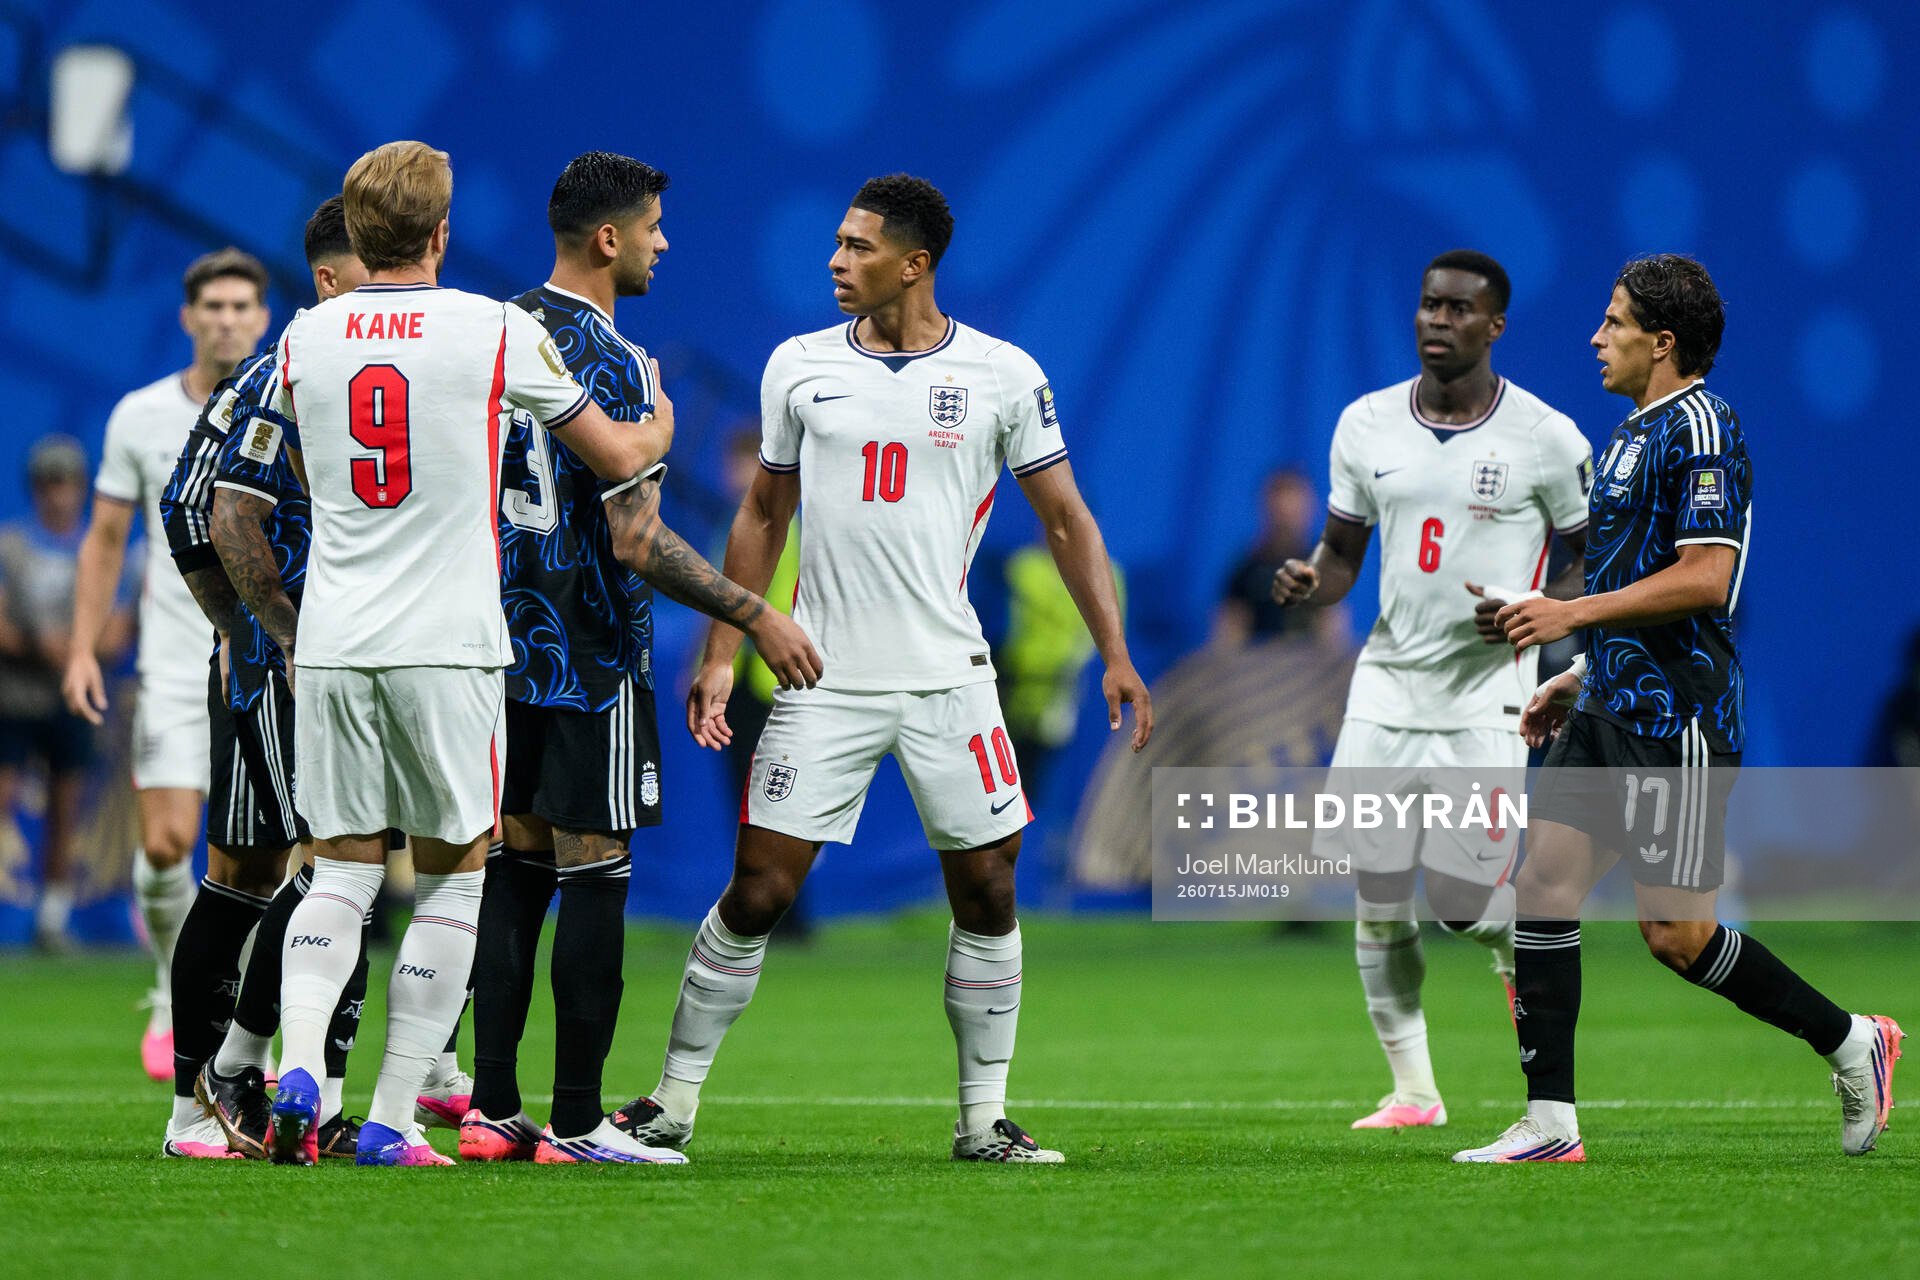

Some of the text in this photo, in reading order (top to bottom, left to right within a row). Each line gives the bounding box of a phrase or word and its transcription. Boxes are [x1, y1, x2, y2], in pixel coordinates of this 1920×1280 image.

[345, 312, 425, 340] KANE
[348, 363, 413, 509] 9
[928, 430, 965, 441] ARGENTINA
[862, 440, 908, 503] 10
[1418, 517, 1445, 573] 6
[967, 726, 1018, 794] 10
[1625, 774, 1671, 836] 17
[290, 935, 332, 949] ENG
[398, 964, 437, 980] ENG
